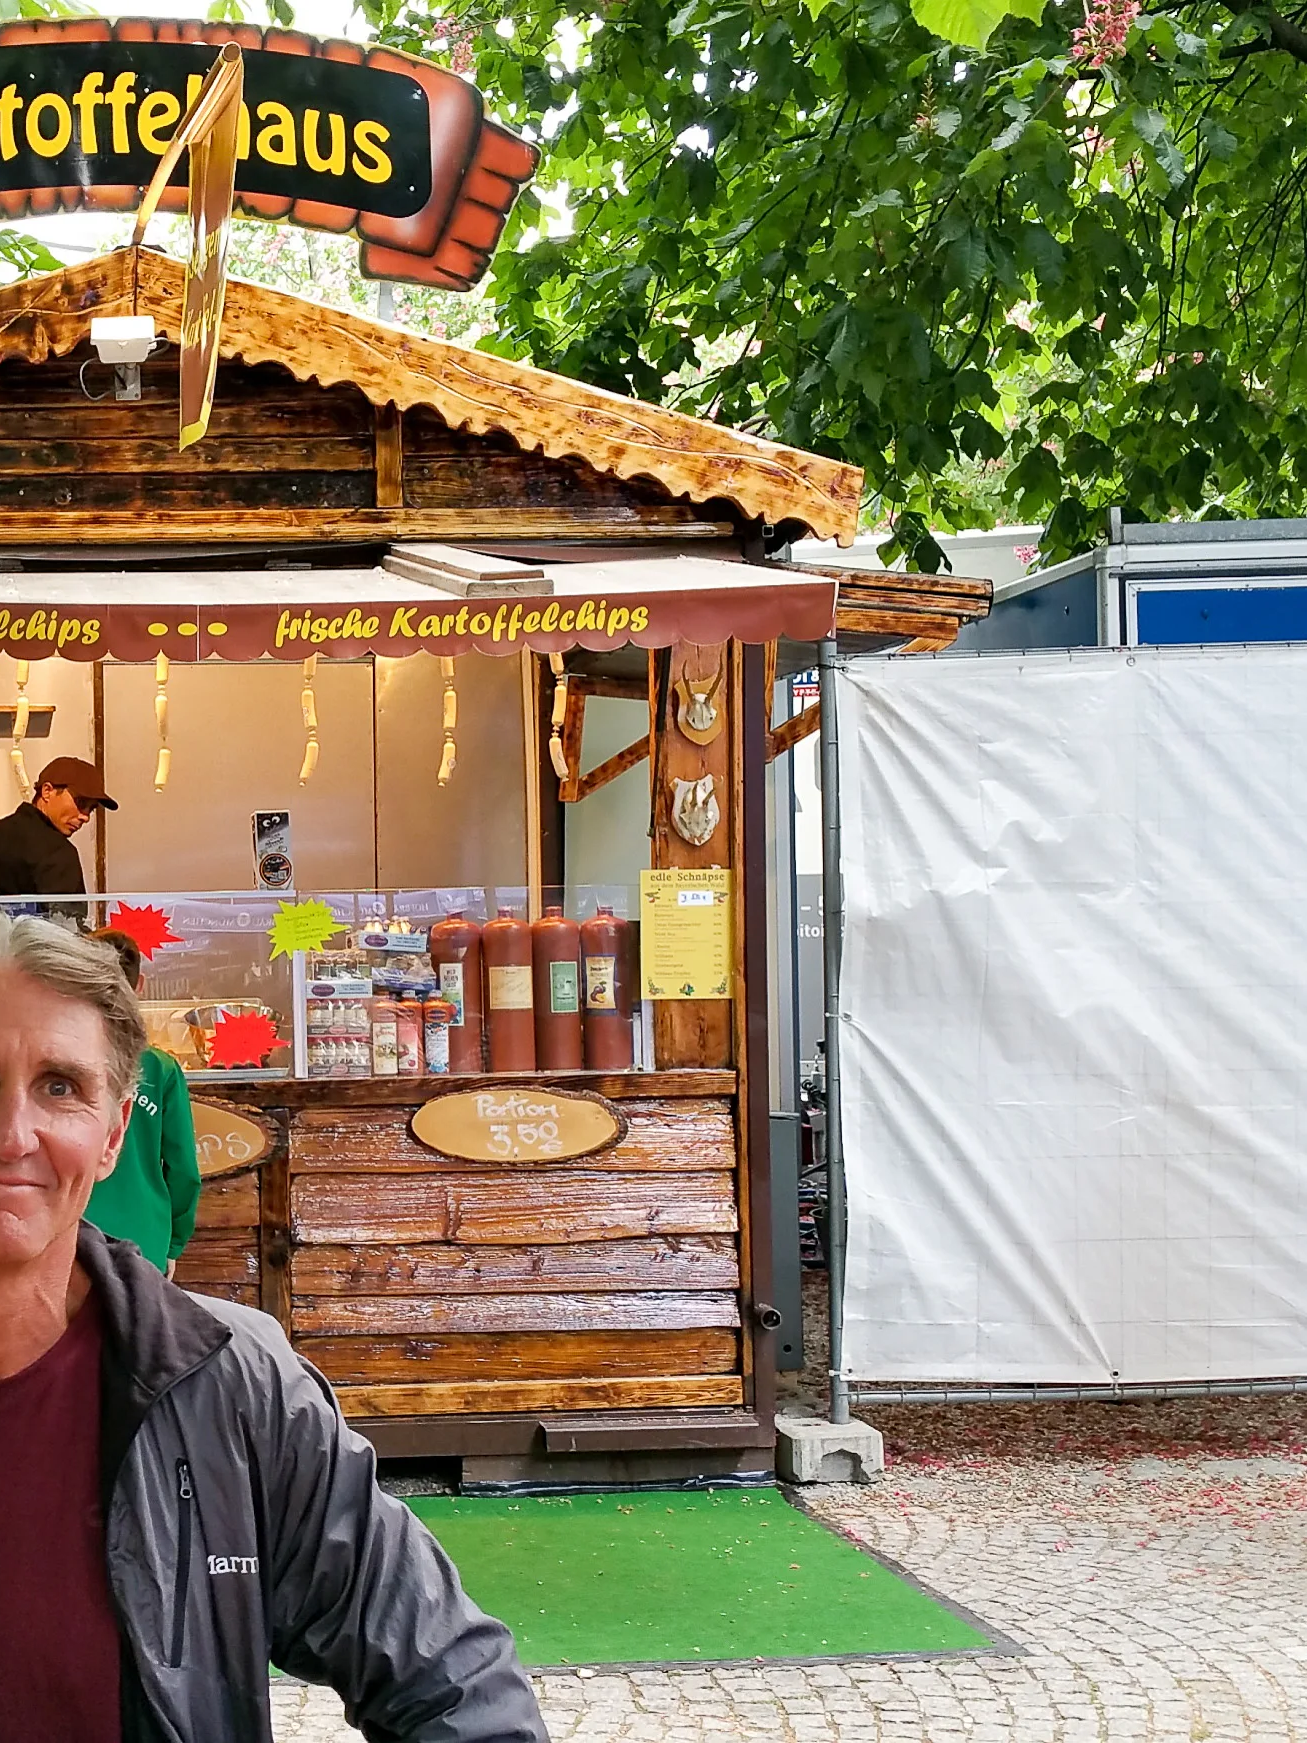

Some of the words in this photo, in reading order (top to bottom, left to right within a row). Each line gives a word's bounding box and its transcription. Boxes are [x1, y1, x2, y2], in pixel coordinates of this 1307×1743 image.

[275, 607, 380, 648] frische
[388, 600, 650, 643] Kartoffelchips
[650, 872, 672, 882] edle
[677, 872, 725, 883] Schnäpse
